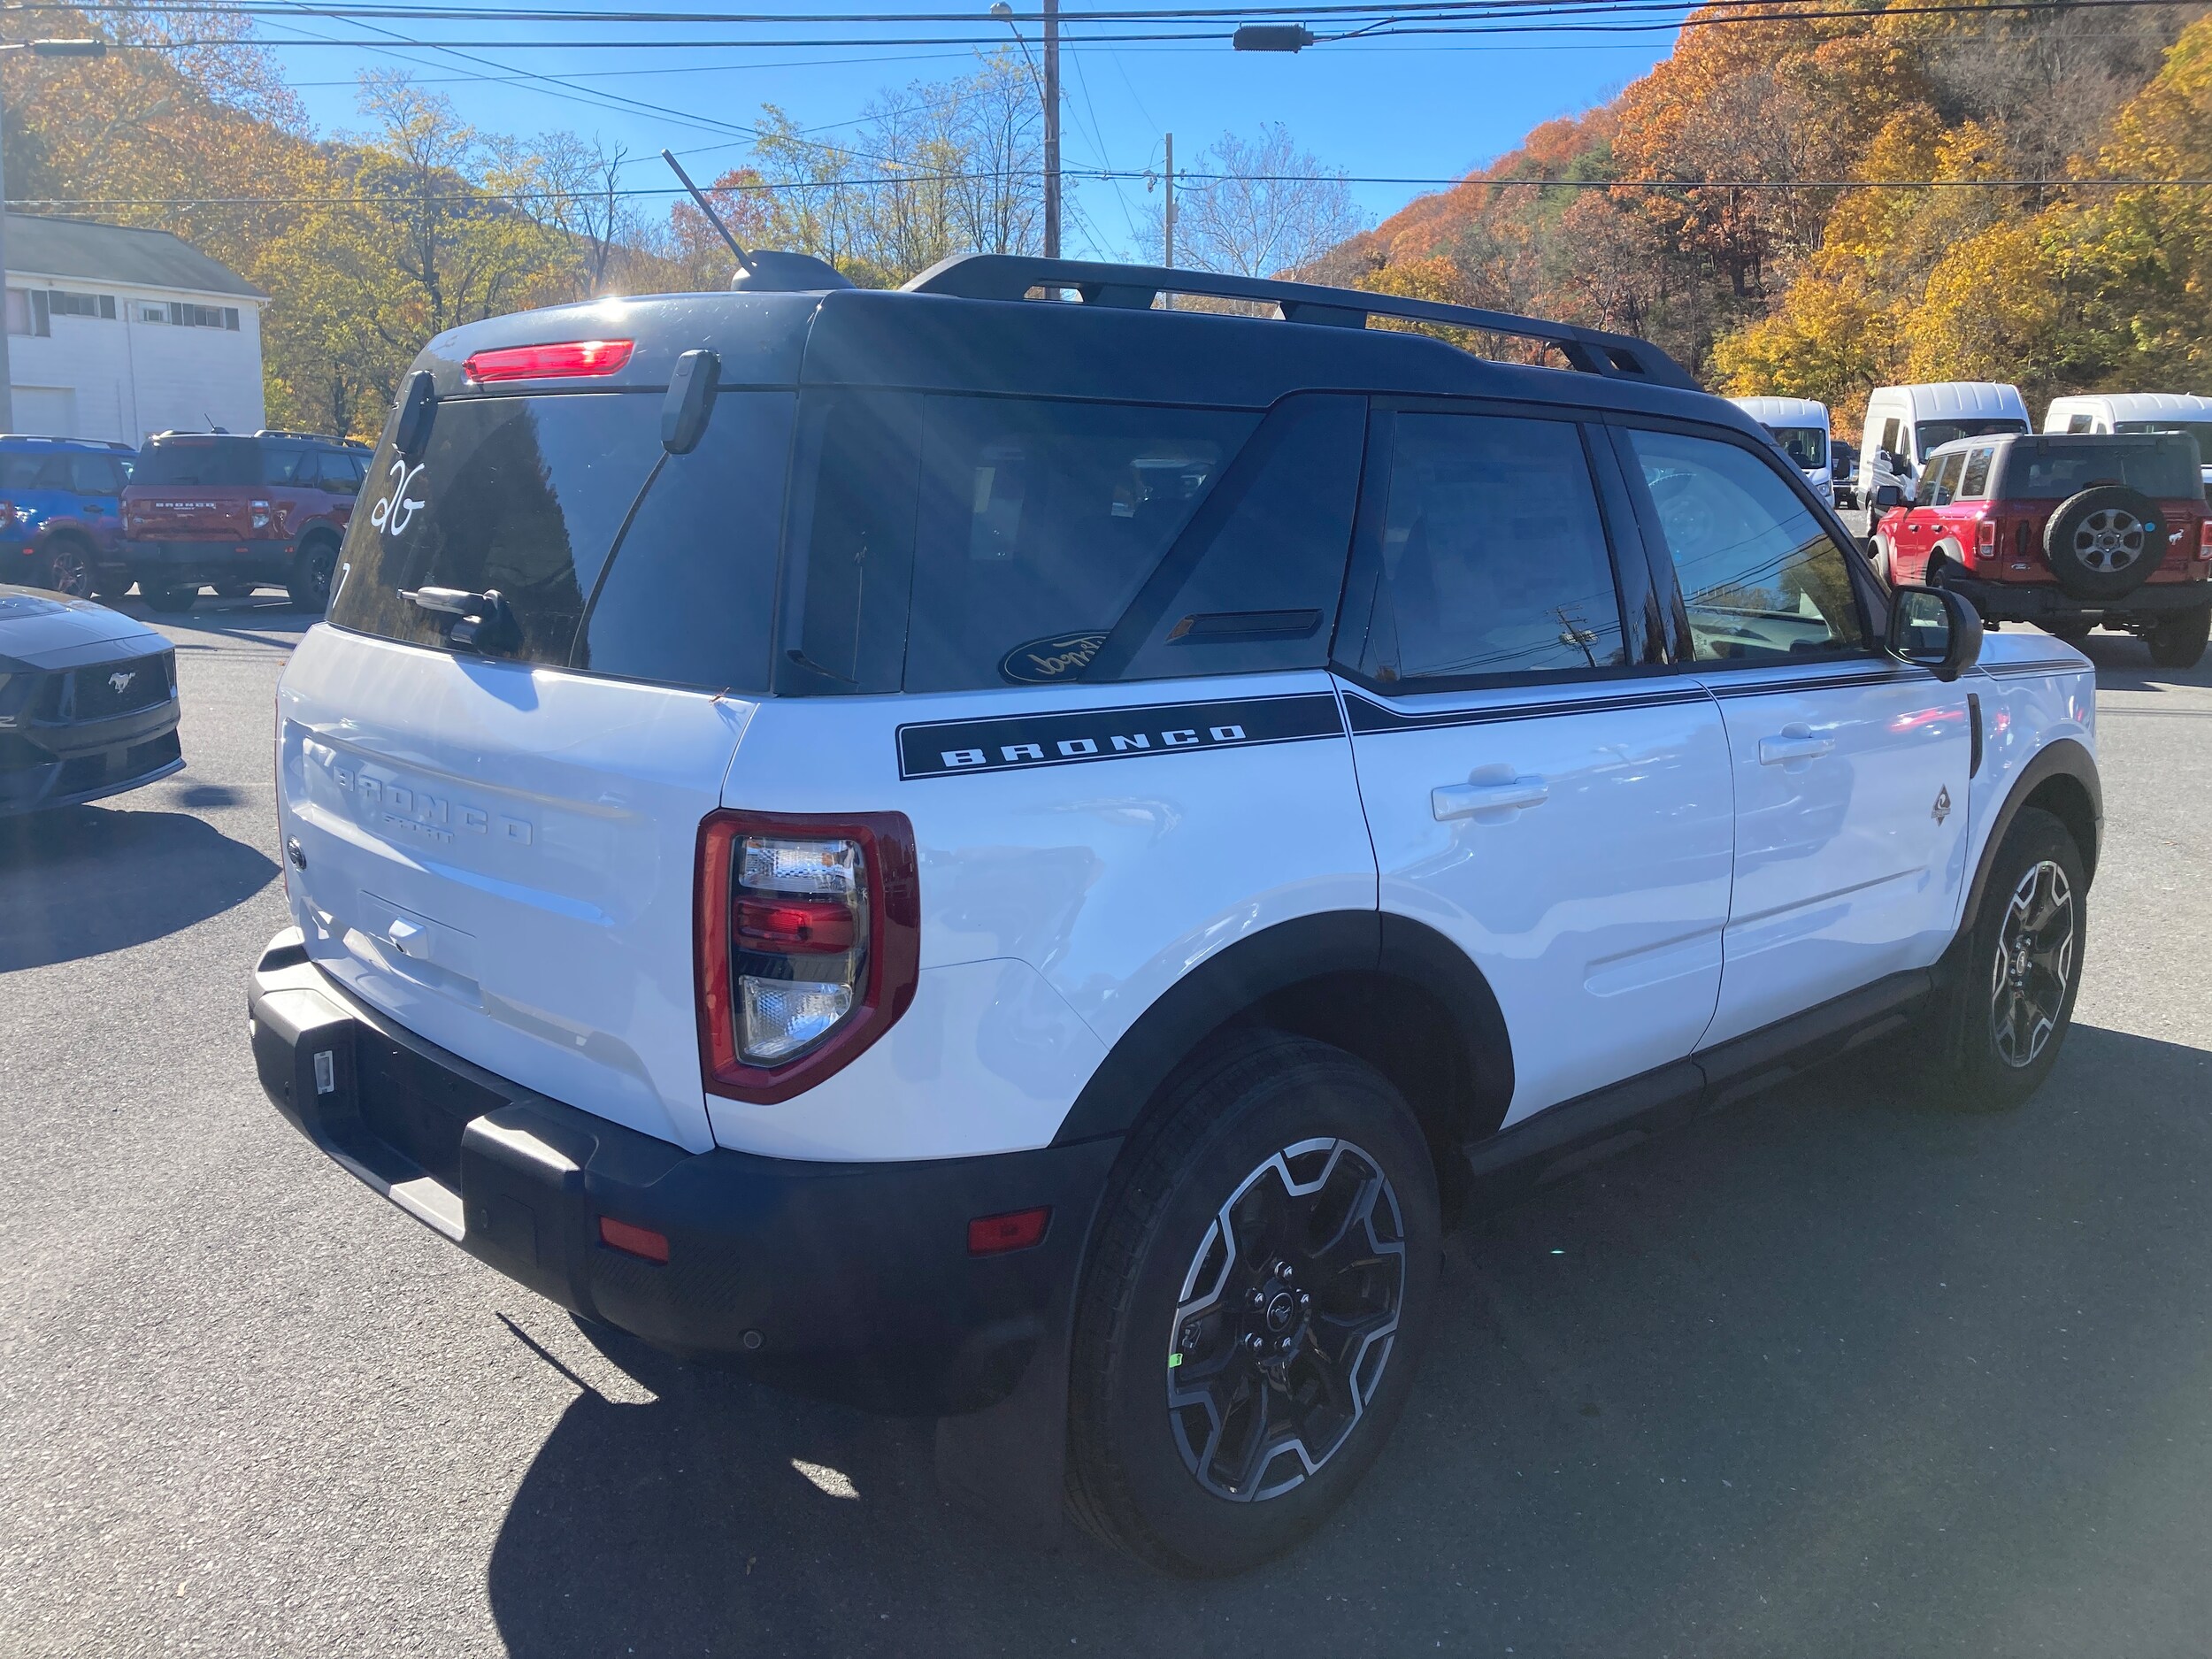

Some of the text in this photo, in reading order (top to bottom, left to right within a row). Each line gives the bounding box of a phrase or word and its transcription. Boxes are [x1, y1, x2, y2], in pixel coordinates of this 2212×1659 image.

[371, 459, 426, 536] 26
[941, 725, 1247, 767] BRONCO
[333, 765, 534, 847] BRONCO
